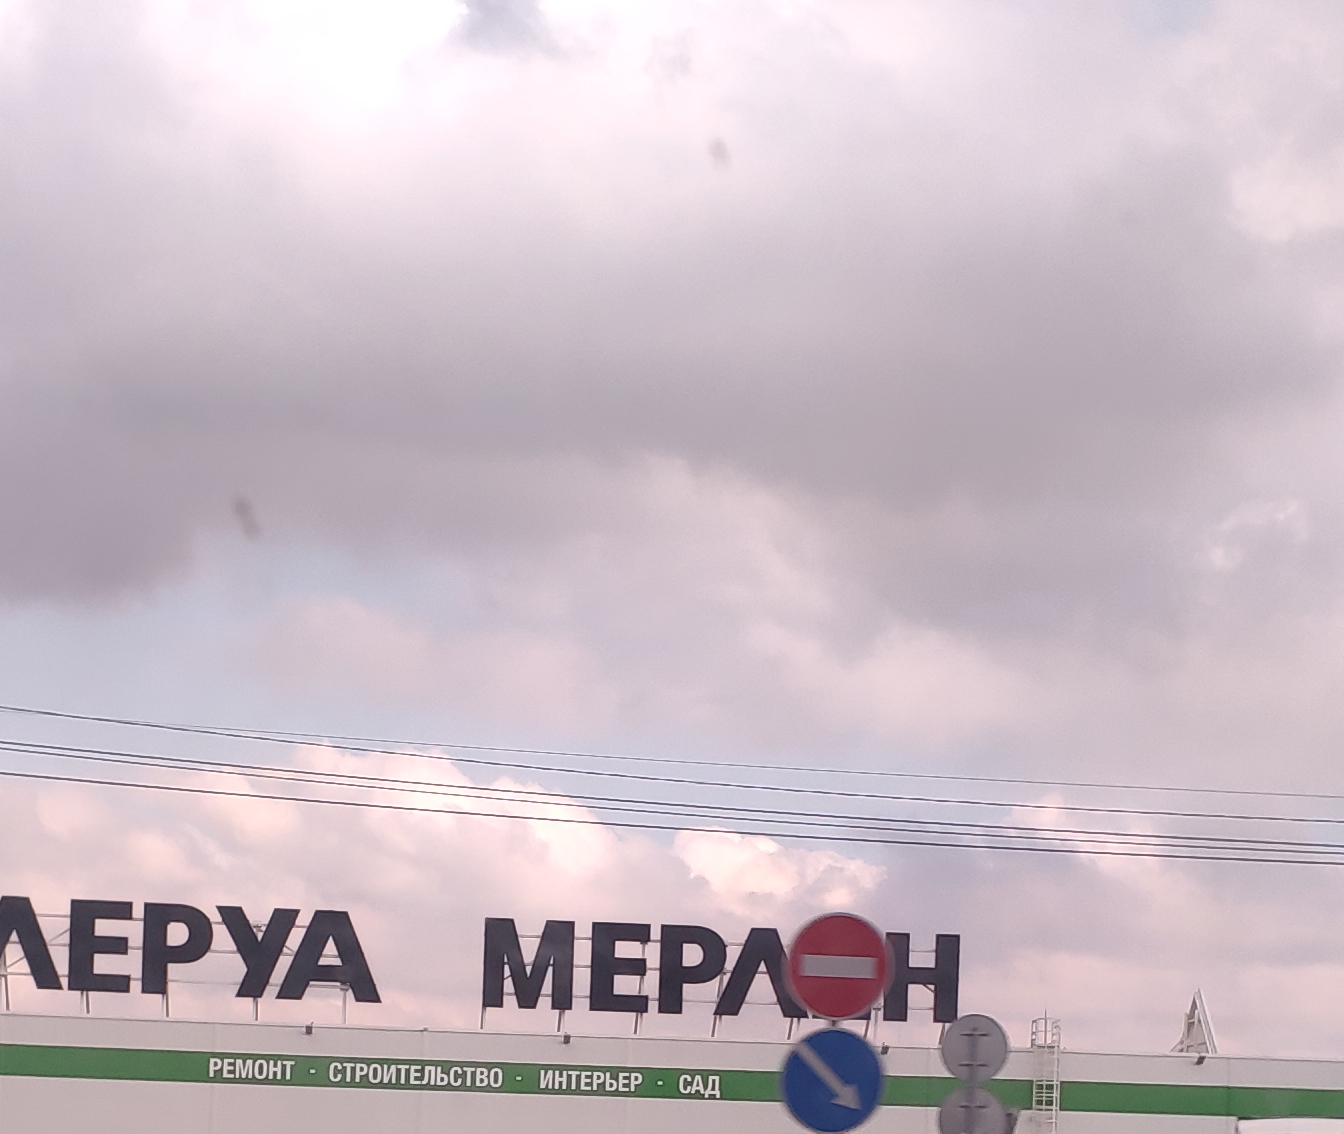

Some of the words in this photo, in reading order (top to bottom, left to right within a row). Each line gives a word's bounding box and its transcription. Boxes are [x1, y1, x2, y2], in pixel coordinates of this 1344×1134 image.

[482, 917, 961, 1024] МЕРЛН
[208, 1057, 296, 1081] РЕМОНТ
[328, 1061, 503, 1088] СТРОИТЕЛЬСТВО
[539, 1069, 643, 1092] ИНТЕРЬЕР
[678, 1073, 722, 1099] САД
